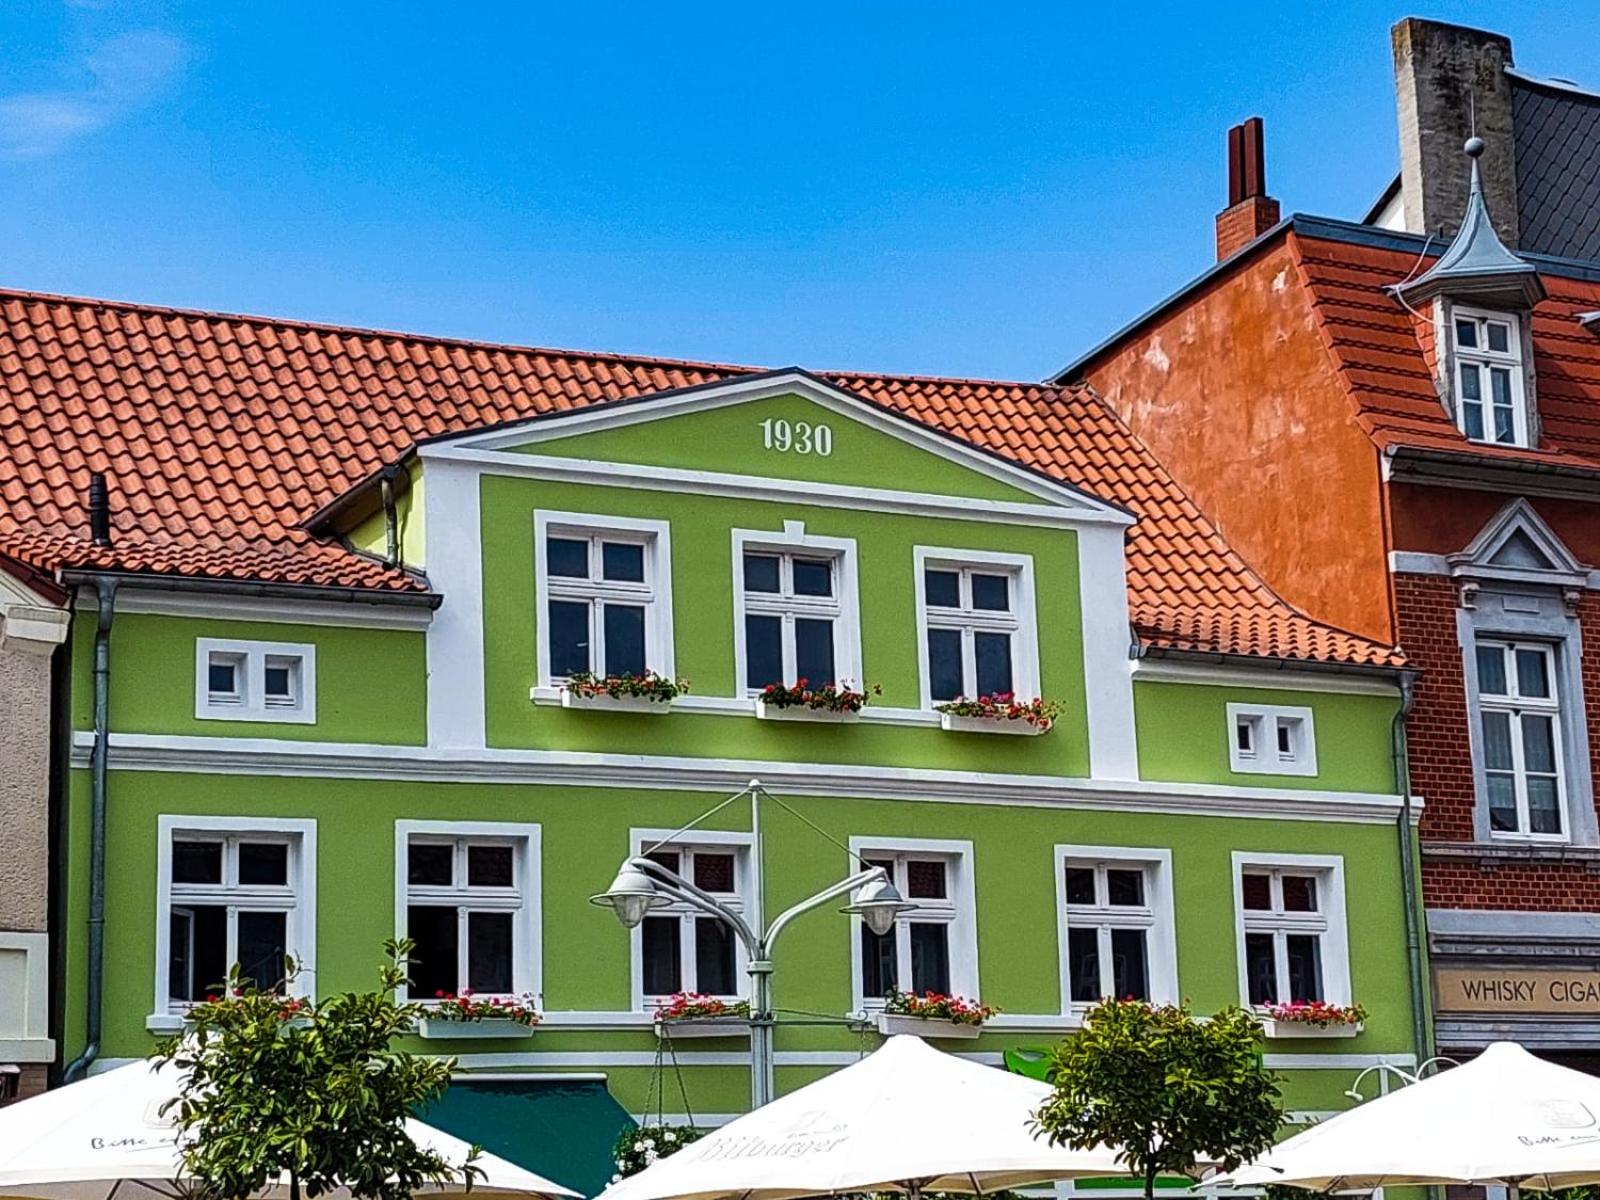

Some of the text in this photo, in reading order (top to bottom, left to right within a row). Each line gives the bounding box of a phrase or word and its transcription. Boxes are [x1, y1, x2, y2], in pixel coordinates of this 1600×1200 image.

[758, 418, 832, 456] 1930
[1461, 980, 1600, 1001] WHISKY CIGA
